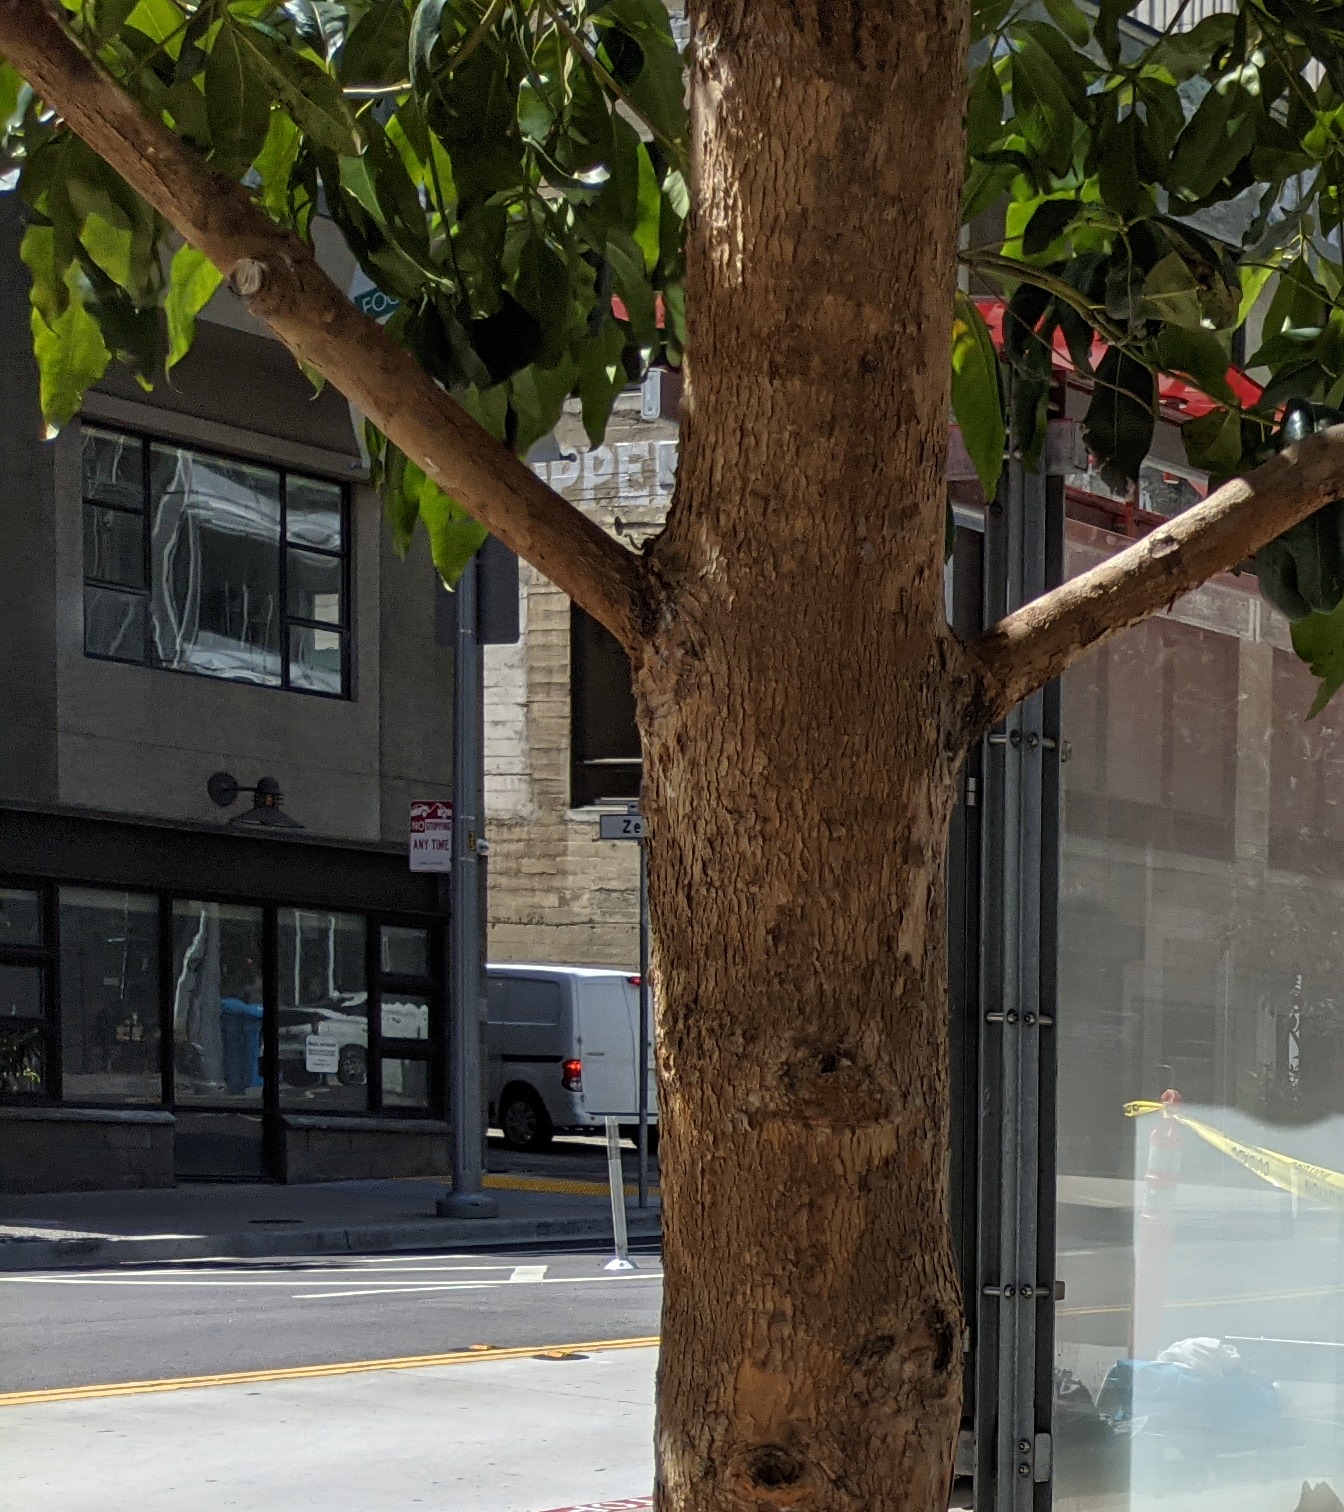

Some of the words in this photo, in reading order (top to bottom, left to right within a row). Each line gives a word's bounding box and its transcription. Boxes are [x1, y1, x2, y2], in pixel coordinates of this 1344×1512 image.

[363, 292, 400, 314] FO
[414, 839, 429, 851] ANY
[431, 839, 449, 851] TIME
